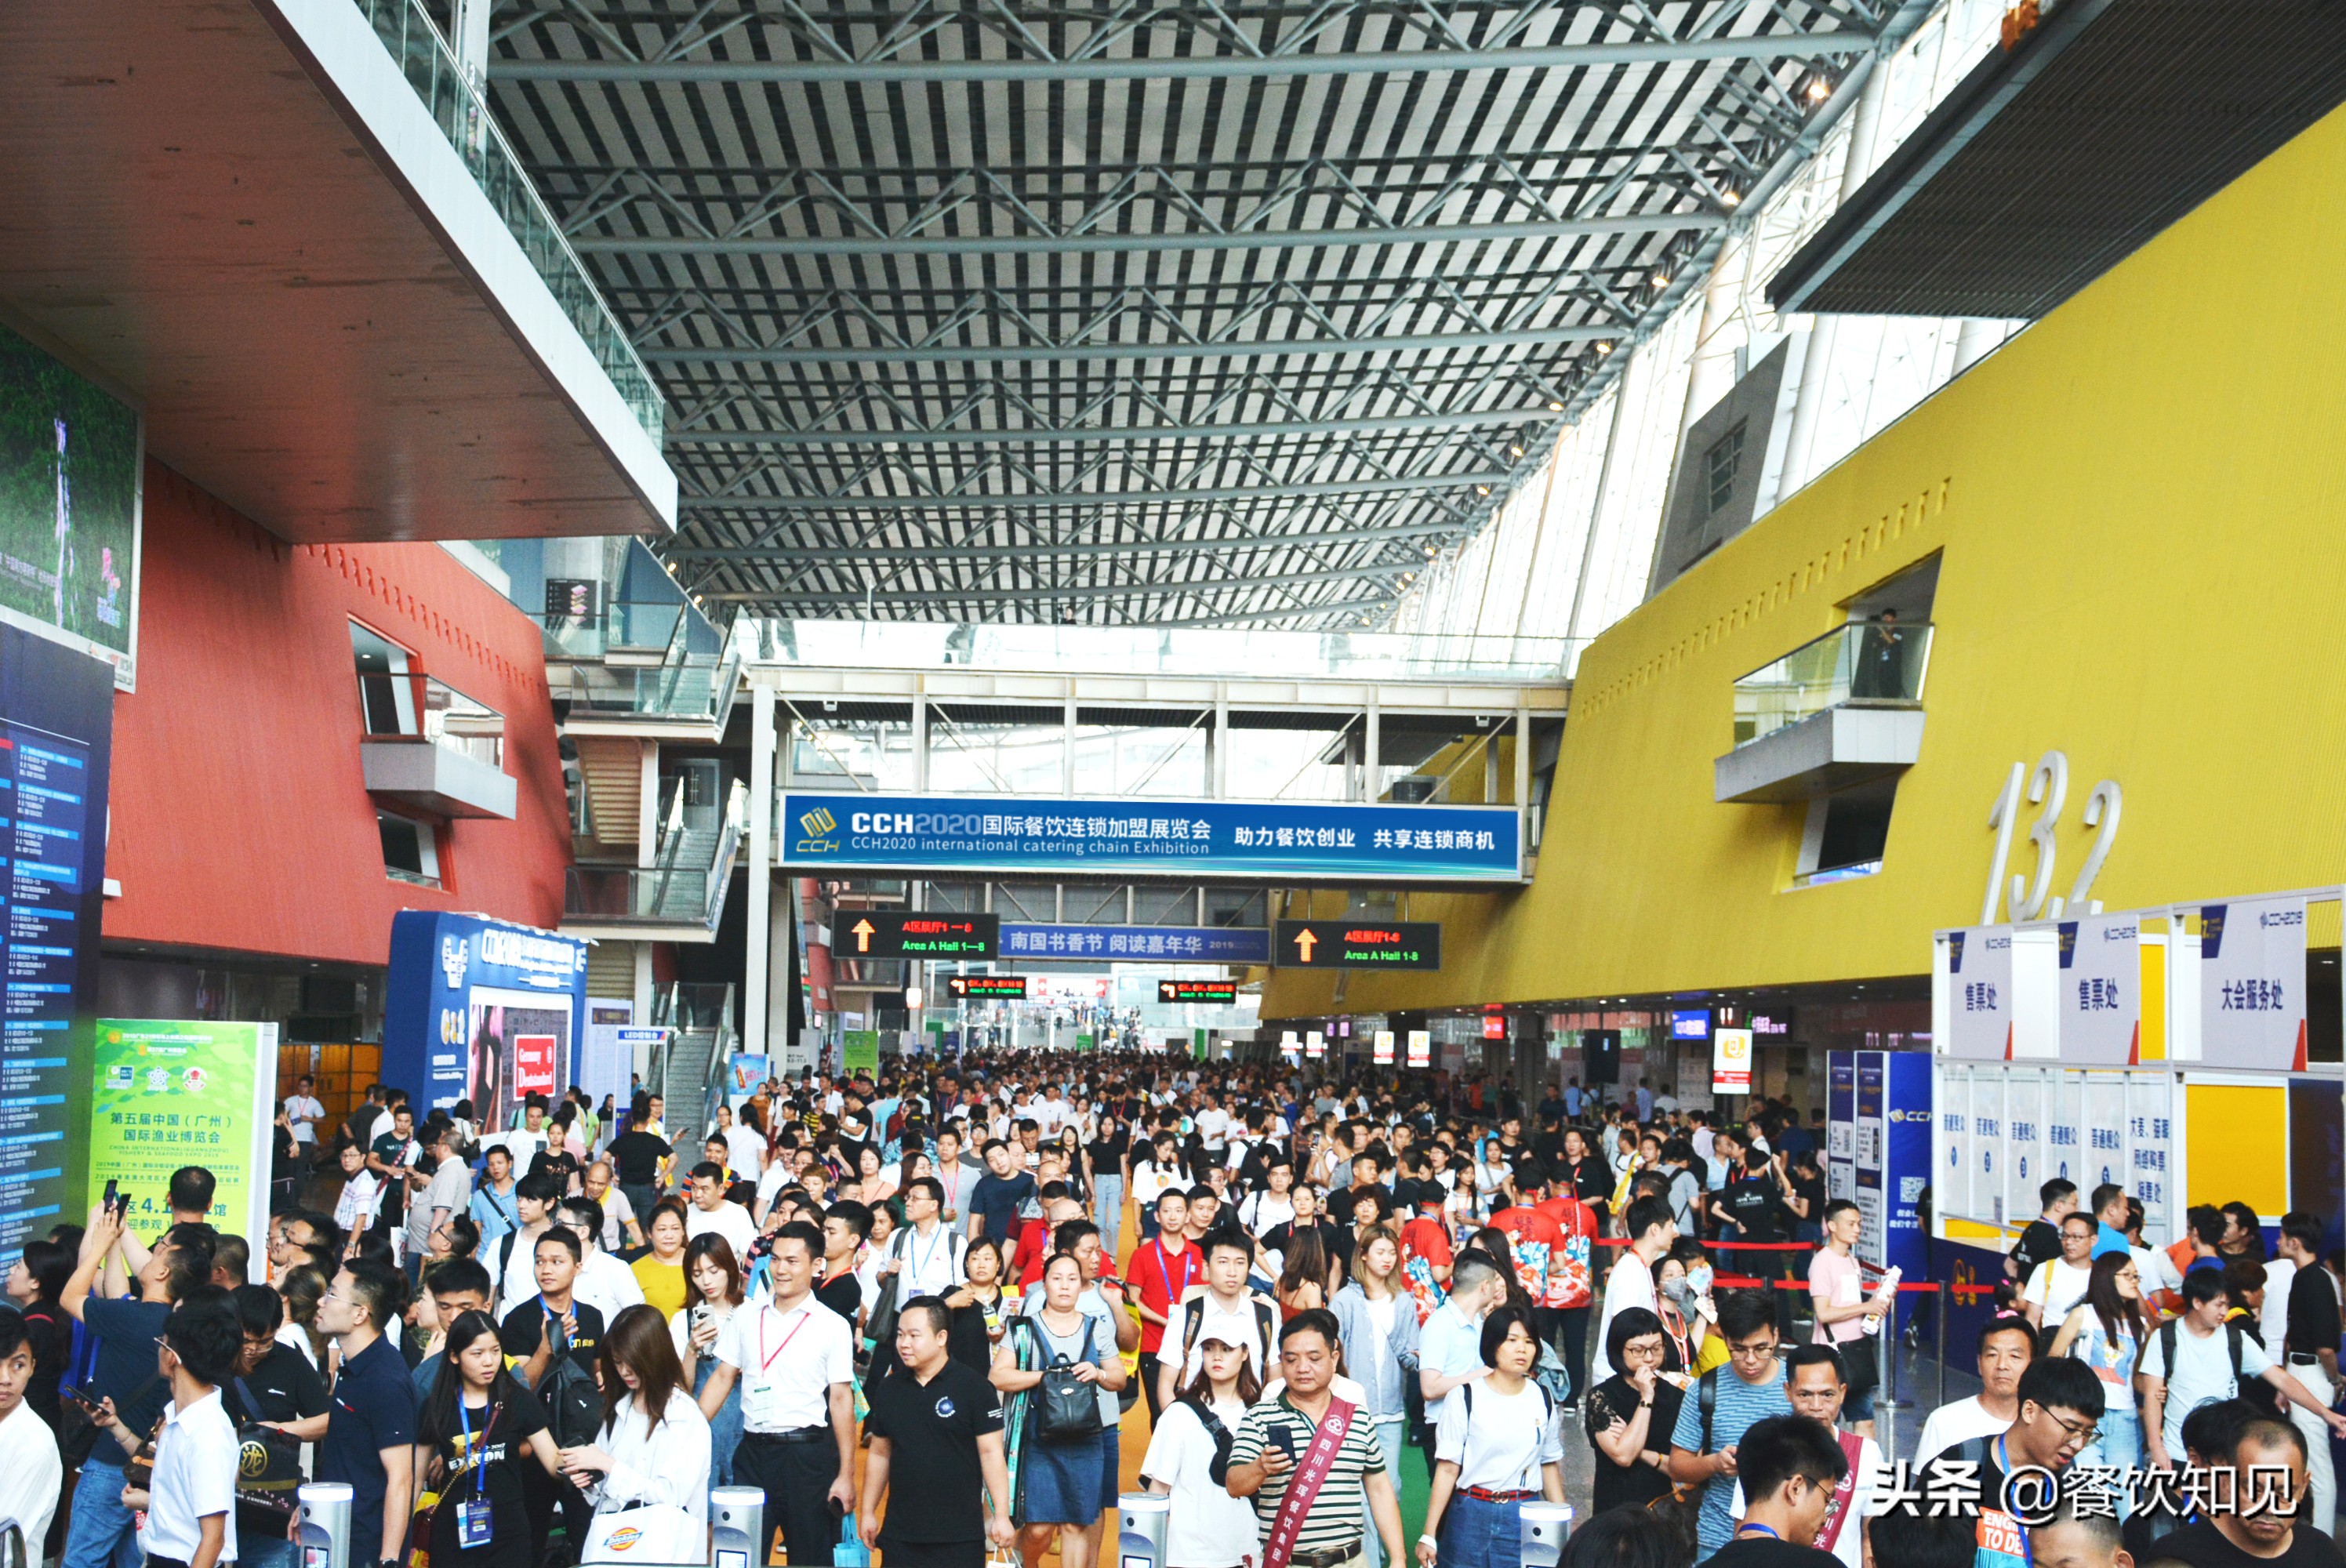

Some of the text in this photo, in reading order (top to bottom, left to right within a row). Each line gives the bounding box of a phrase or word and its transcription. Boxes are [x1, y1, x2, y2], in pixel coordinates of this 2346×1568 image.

[852, 811, 1495, 851] CCH2020国际餐饮连锁加盟展览会 助力餐饮创业 共享连锁商机
[1979, 750, 2122, 926] 13.2
[796, 839, 841, 852] CCH
[852, 836, 1209, 855] CCH2020 international catering chain Exhibition
[928, 941, 937, 951] A
[1010, 931, 1104, 953] 南国书香节
[1109, 934, 1204, 954] 阅读嘉年华
[1345, 950, 1367, 961] Area
[1370, 950, 1379, 960] A
[1382, 950, 1400, 961] Hall
[1966, 982, 1997, 1011] 售票处
[2079, 978, 2119, 1011] 售票处
[2221, 978, 2283, 1011] 大会服务处
[124, 1129, 221, 1144] 国际渔业博览会
[1985, 1526, 2003, 1549] TO
